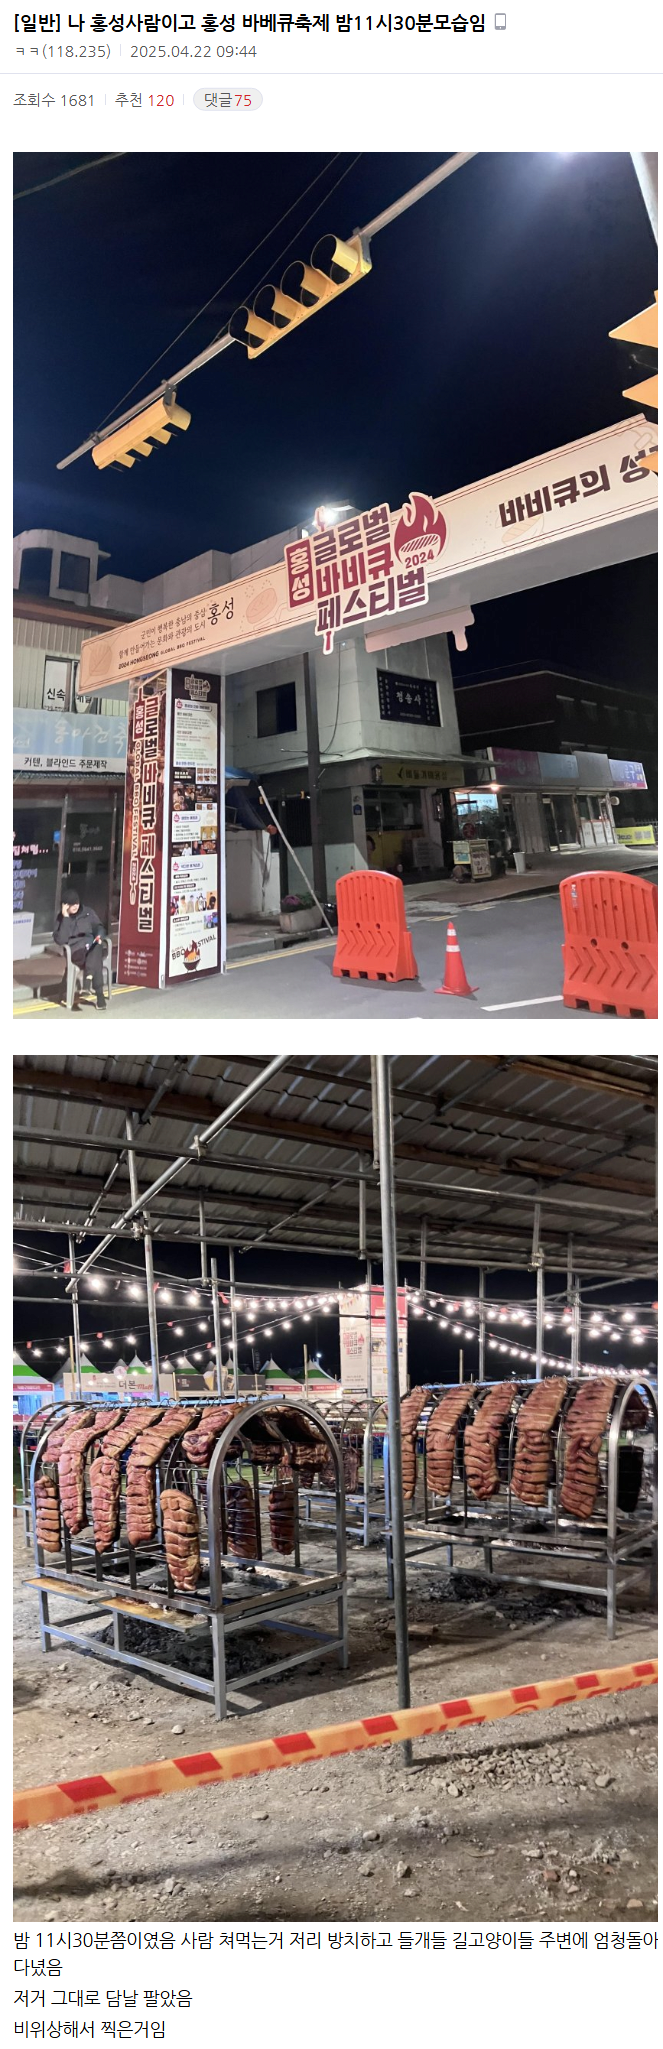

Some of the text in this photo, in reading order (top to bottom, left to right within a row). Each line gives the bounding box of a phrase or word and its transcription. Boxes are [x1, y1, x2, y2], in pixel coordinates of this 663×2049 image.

[499, 464, 611, 527] 바비큐의
[314, 506, 391, 566] 글로벌
[405, 549, 435, 569] 2024
[289, 547, 311, 601] 홍성
[316, 542, 394, 599] 바비큐
[207, 597, 235, 626] 홍성
[317, 567, 425, 632] 페스티벌
[118, 647, 129, 660] 함께
[156, 631, 174, 645] 문화와
[175, 625, 193, 640] 관광의
[193, 619, 206, 632] 도시
[140, 607, 206, 640] 군민이 행복한 충남의 중심
[118, 661, 130, 670] 2024
[130, 650, 159, 667] HONGSEONG
[47, 687, 66, 702] 신속
[135, 705, 144, 735] 홍성
[144, 696, 159, 760] 글로벌
[24, 757, 108, 769] 커텐, 블라인드 주문제작
[142, 762, 157, 827] 바비큐
[138, 835, 155, 930] 페스티벌
